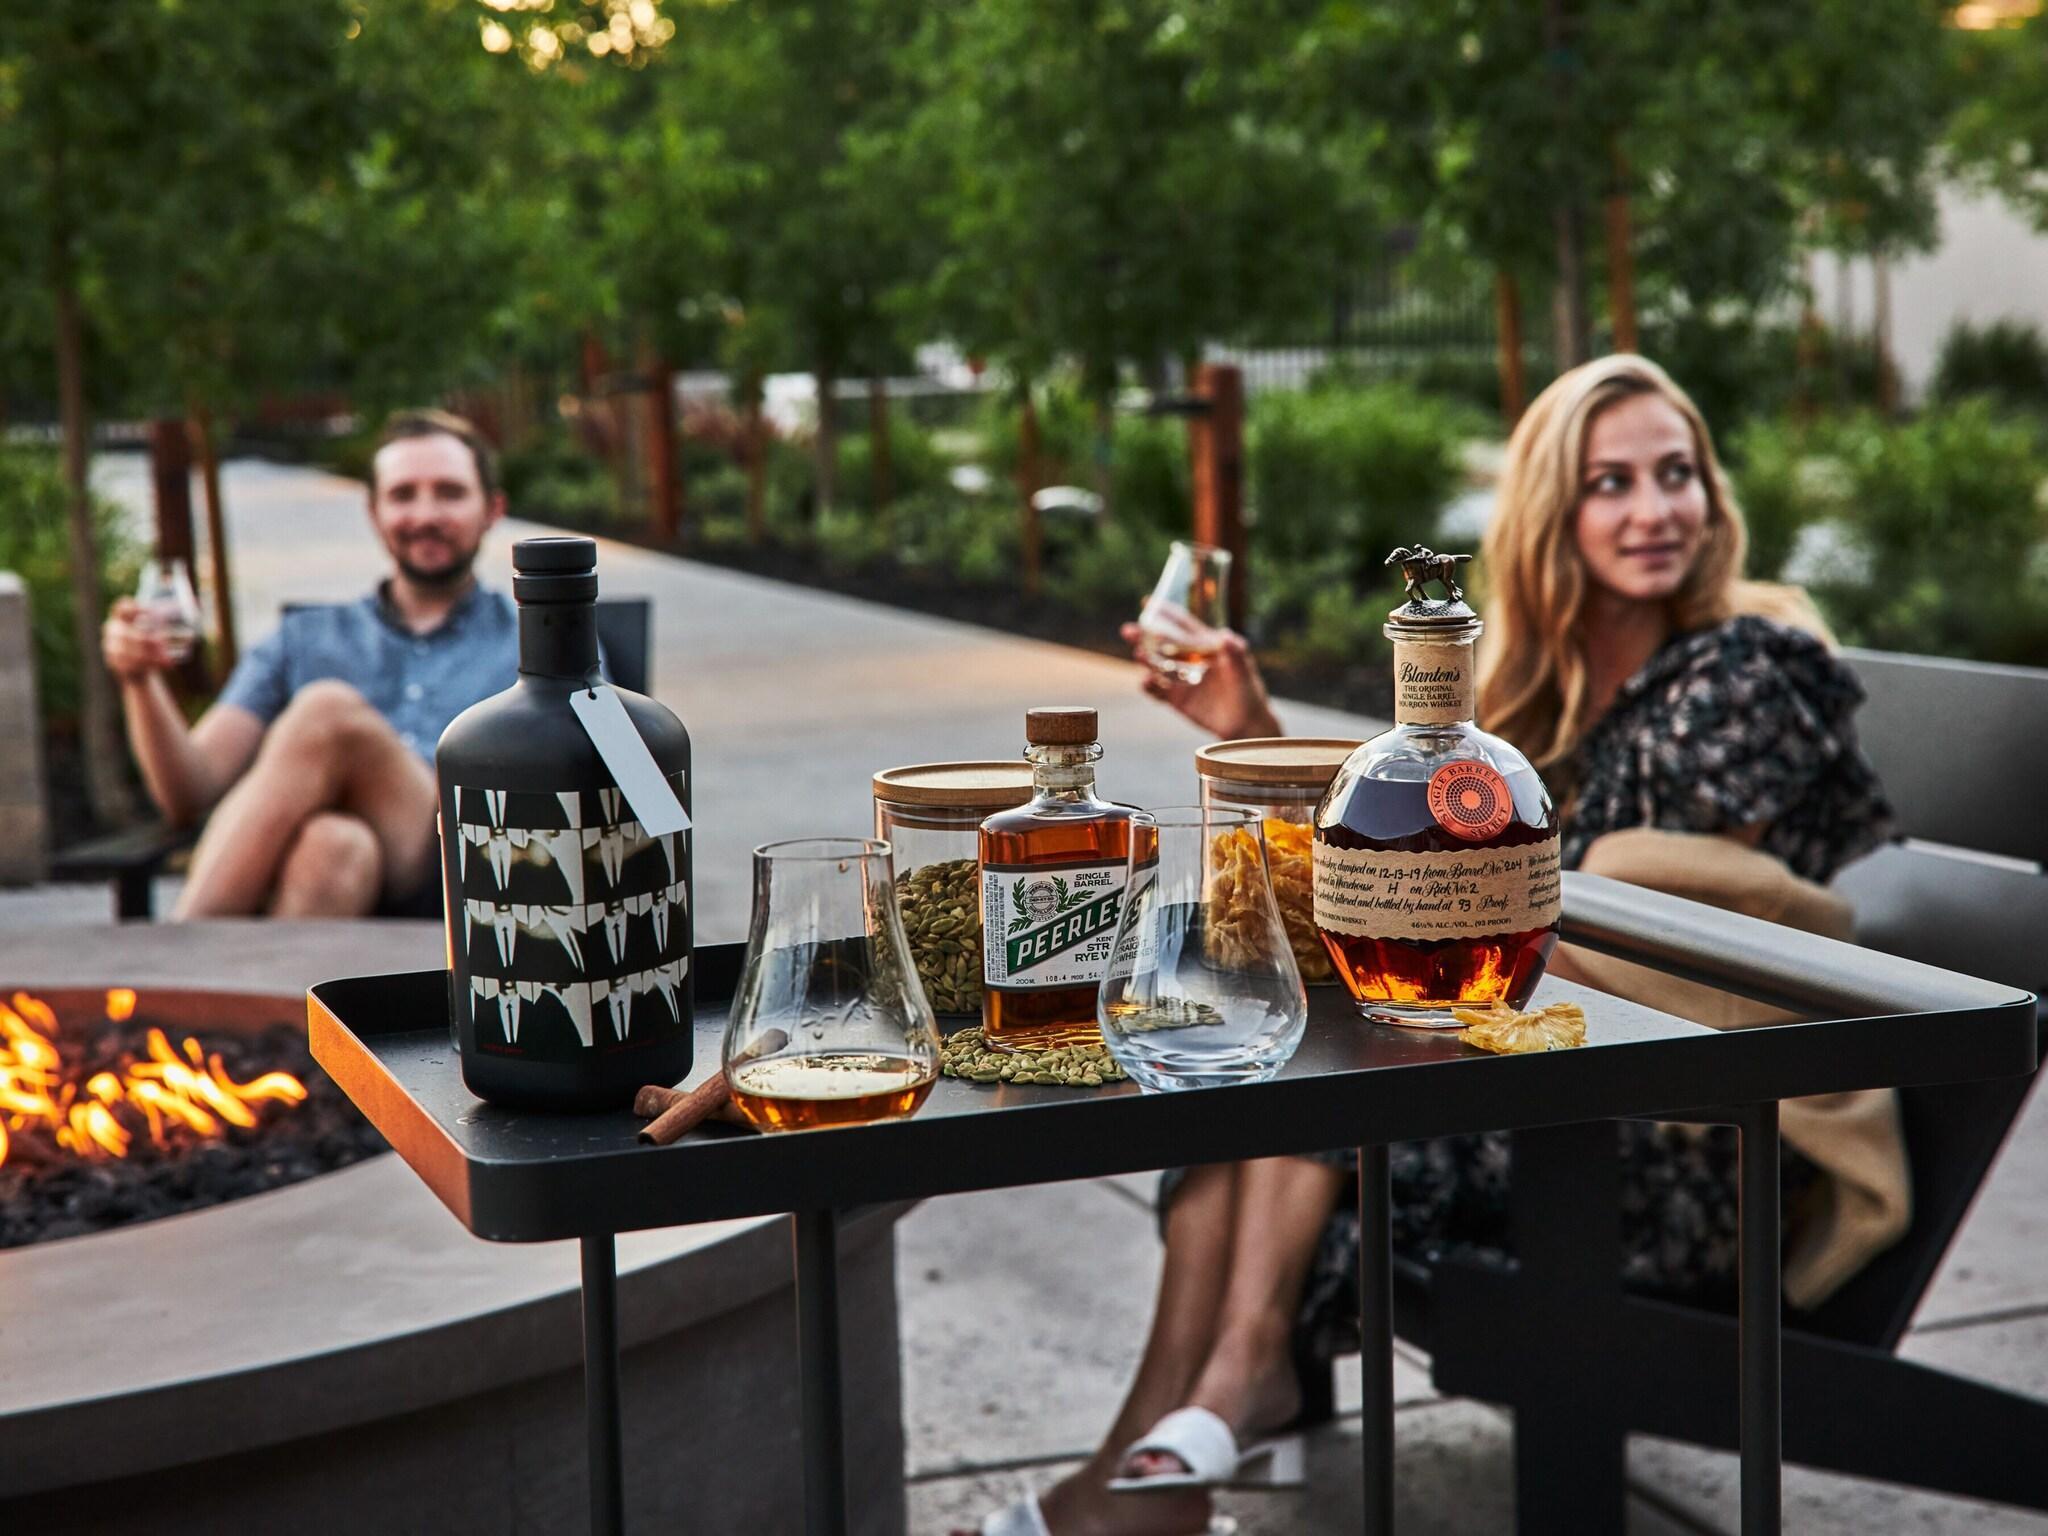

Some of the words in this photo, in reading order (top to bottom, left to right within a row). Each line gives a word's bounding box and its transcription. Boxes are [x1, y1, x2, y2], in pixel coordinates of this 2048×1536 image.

[1400, 662, 1460, 682] Blanton's
[1419, 685, 1454, 693] ORIGINAL
[1430, 700, 1462, 708] WHISKEY
[1433, 776, 1449, 822] SINGLE
[1448, 765, 1499, 786] BARREL
[1471, 806, 1508, 837] SELECT
[1075, 872, 1111, 881] SINGLE
[1337, 859, 1367, 877] dumped
[1366, 867, 1377, 876] on
[1379, 867, 1421, 880] 12-13-19
[1421, 864, 1446, 881] from
[1446, 861, 1485, 880] Barrel
[1504, 858, 1522, 871] 204
[1074, 879, 1113, 888] BARREL
[1333, 874, 1375, 892] Warehouse
[1388, 882, 1399, 895] H
[1410, 885, 1422, 895] on
[1422, 880, 1452, 898] Rick
[1470, 882, 1480, 894] 2
[1357, 897, 1375, 911] and
[1374, 896, 1403, 912] bottled
[1403, 898, 1416, 915] by
[1415, 897, 1444, 913] hand
[1442, 899, 1453, 911] at
[1459, 899, 1471, 911] 93
[1075, 952, 1099, 962] RYE
[1045, 974, 1066, 982] 108.4
